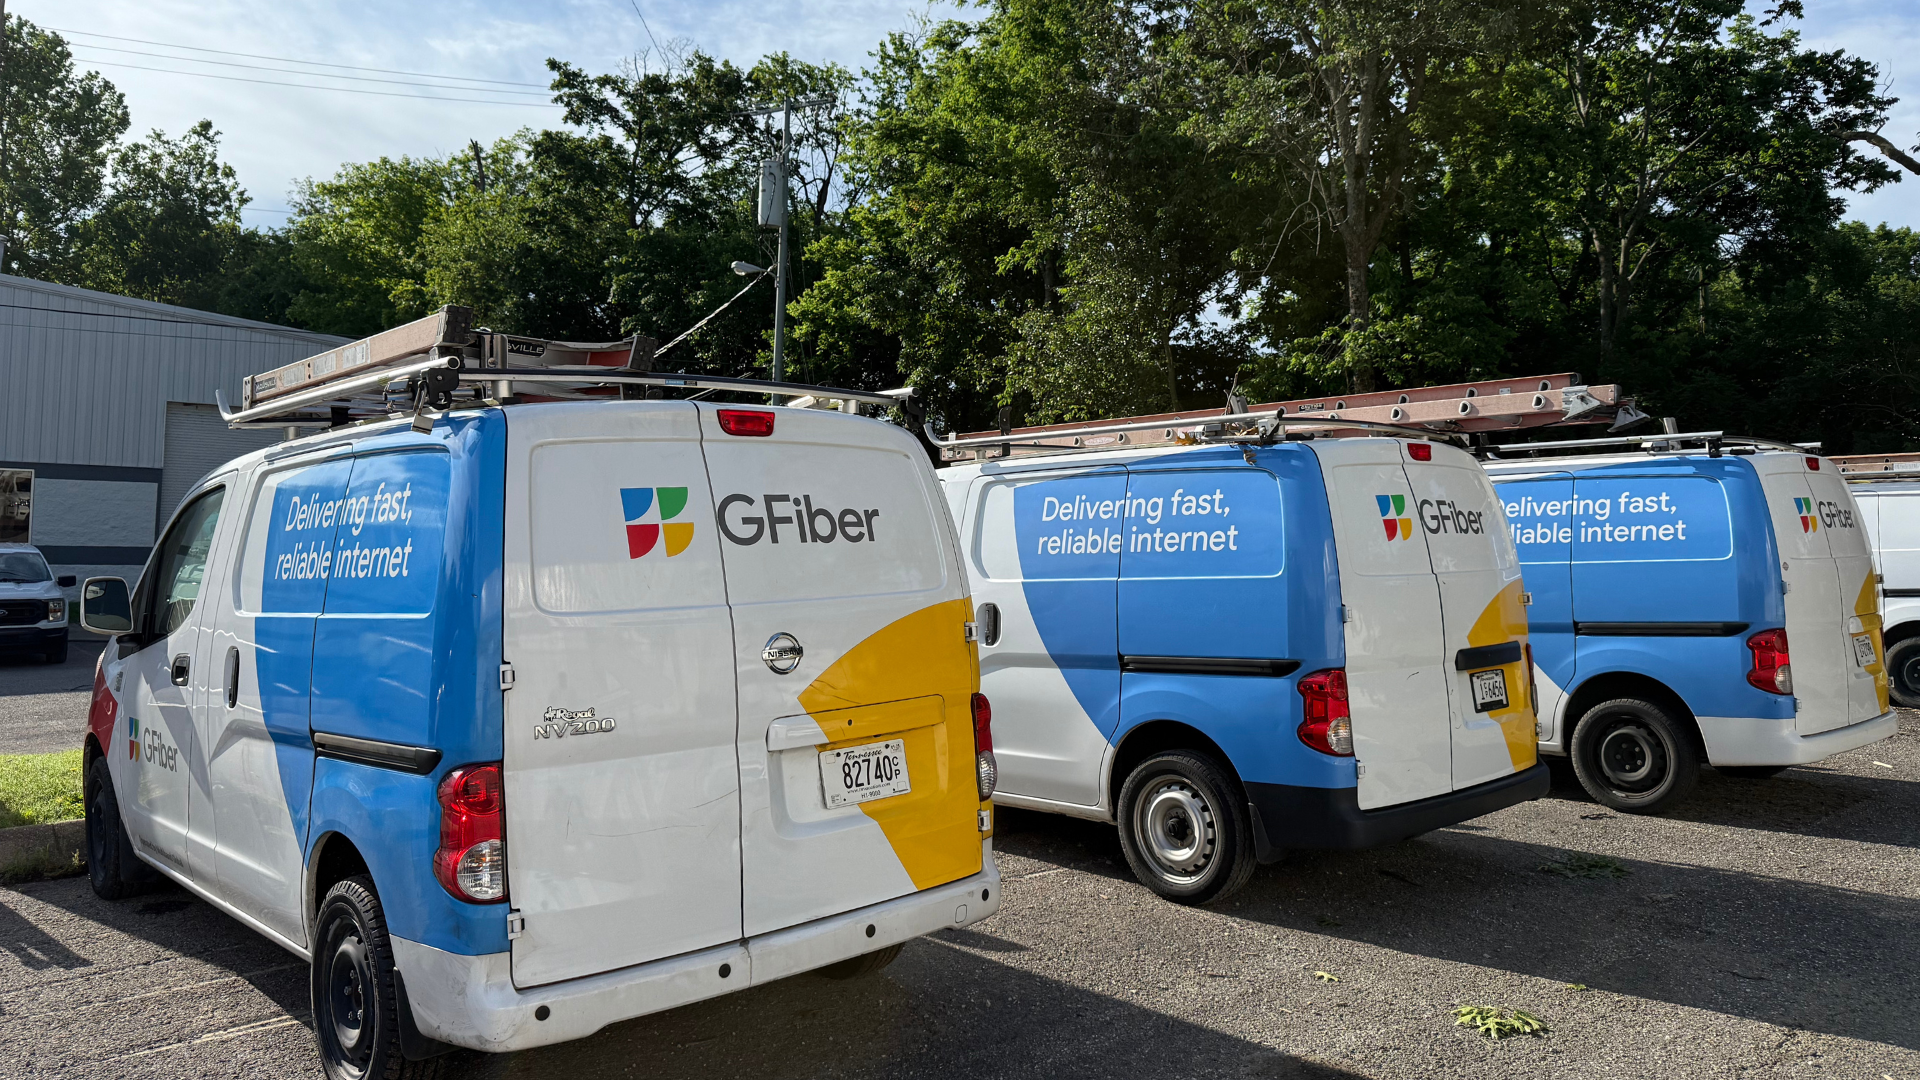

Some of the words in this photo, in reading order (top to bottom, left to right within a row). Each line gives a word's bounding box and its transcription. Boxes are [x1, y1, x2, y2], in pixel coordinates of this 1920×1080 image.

[285, 487, 369, 536] Delivering
[371, 482, 412, 525] fast,
[1041, 491, 1164, 525] Delivering
[1171, 488, 1230, 517] fast,
[1419, 498, 1485, 535] GFiber
[1618, 491, 1677, 515] fast,
[1818, 500, 1855, 529] GFiber
[717, 493, 880, 546] GFiber
[1511, 522, 1572, 544] liable
[1580, 520, 1687, 543] internet
[1037, 527, 1122, 555] reliable
[1130, 525, 1239, 553] internet
[275, 541, 332, 580] reliable
[334, 538, 413, 579] internet
[767, 648, 801, 659] NISSAN
[534, 718, 616, 740] NV200
[556, 707, 596, 722] Regal
[143, 727, 178, 772] GFiber
[843, 749, 882, 762] Tennessee
